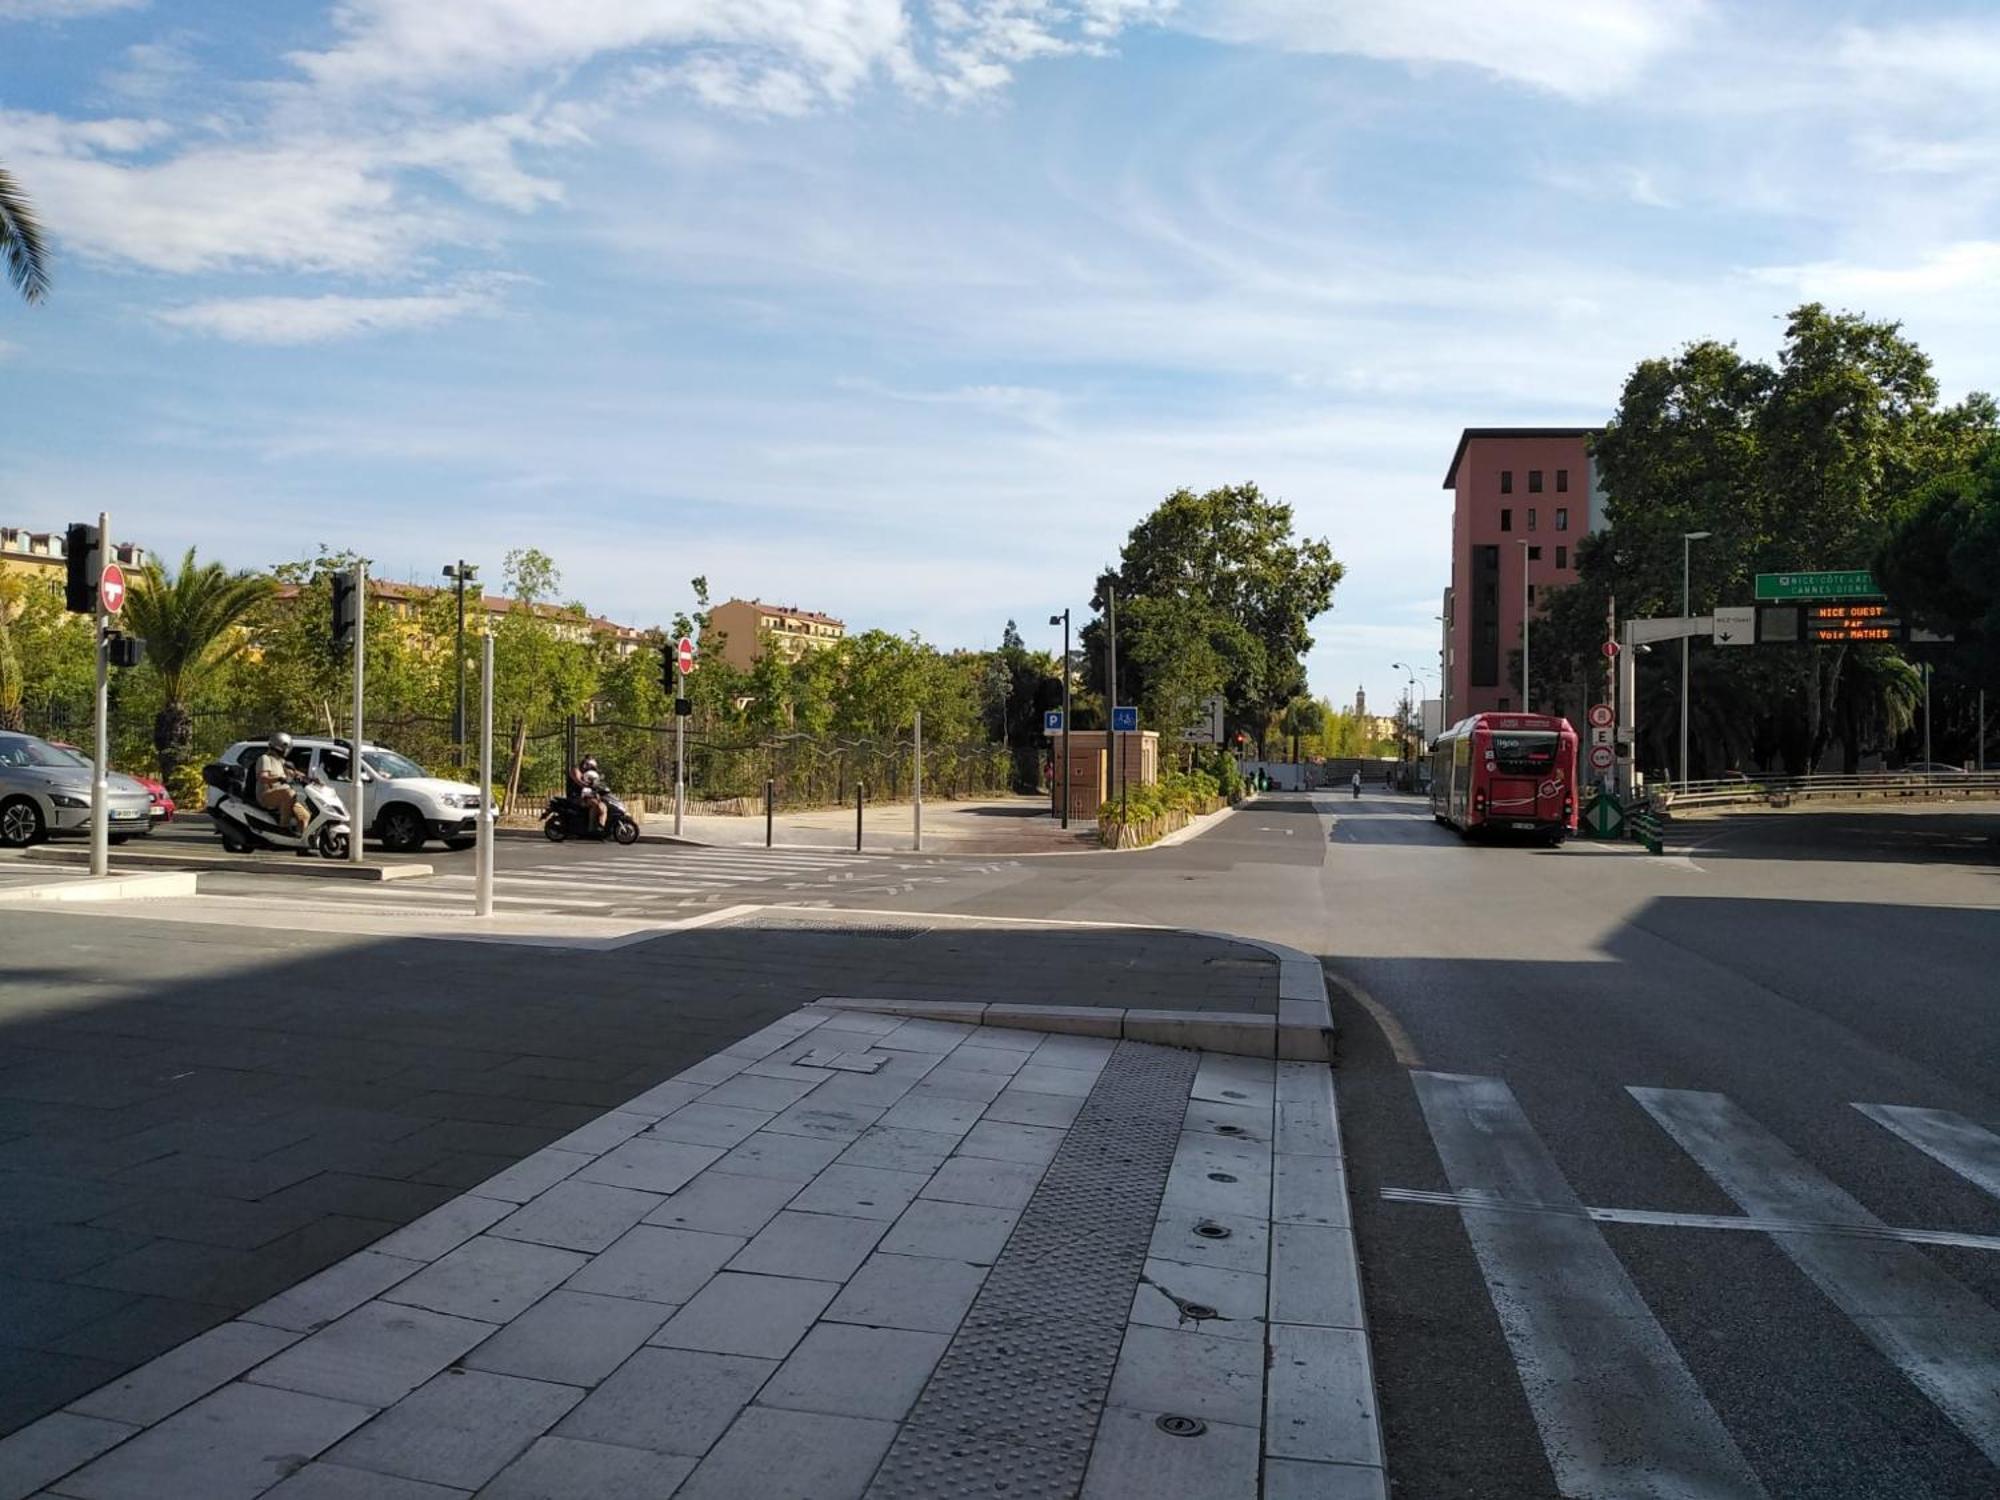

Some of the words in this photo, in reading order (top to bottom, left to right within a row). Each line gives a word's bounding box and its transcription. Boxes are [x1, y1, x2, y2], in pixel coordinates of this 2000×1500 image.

[1791, 585, 1831, 594] CANNES
[1819, 607, 1845, 617] NICE
[1850, 606, 1882, 616] OUEST
[1819, 630, 1845, 640] Voie
[1850, 629, 1889, 639] MATHIS
[1049, 715, 1058, 726] P
[1599, 731, 1607, 742] E
